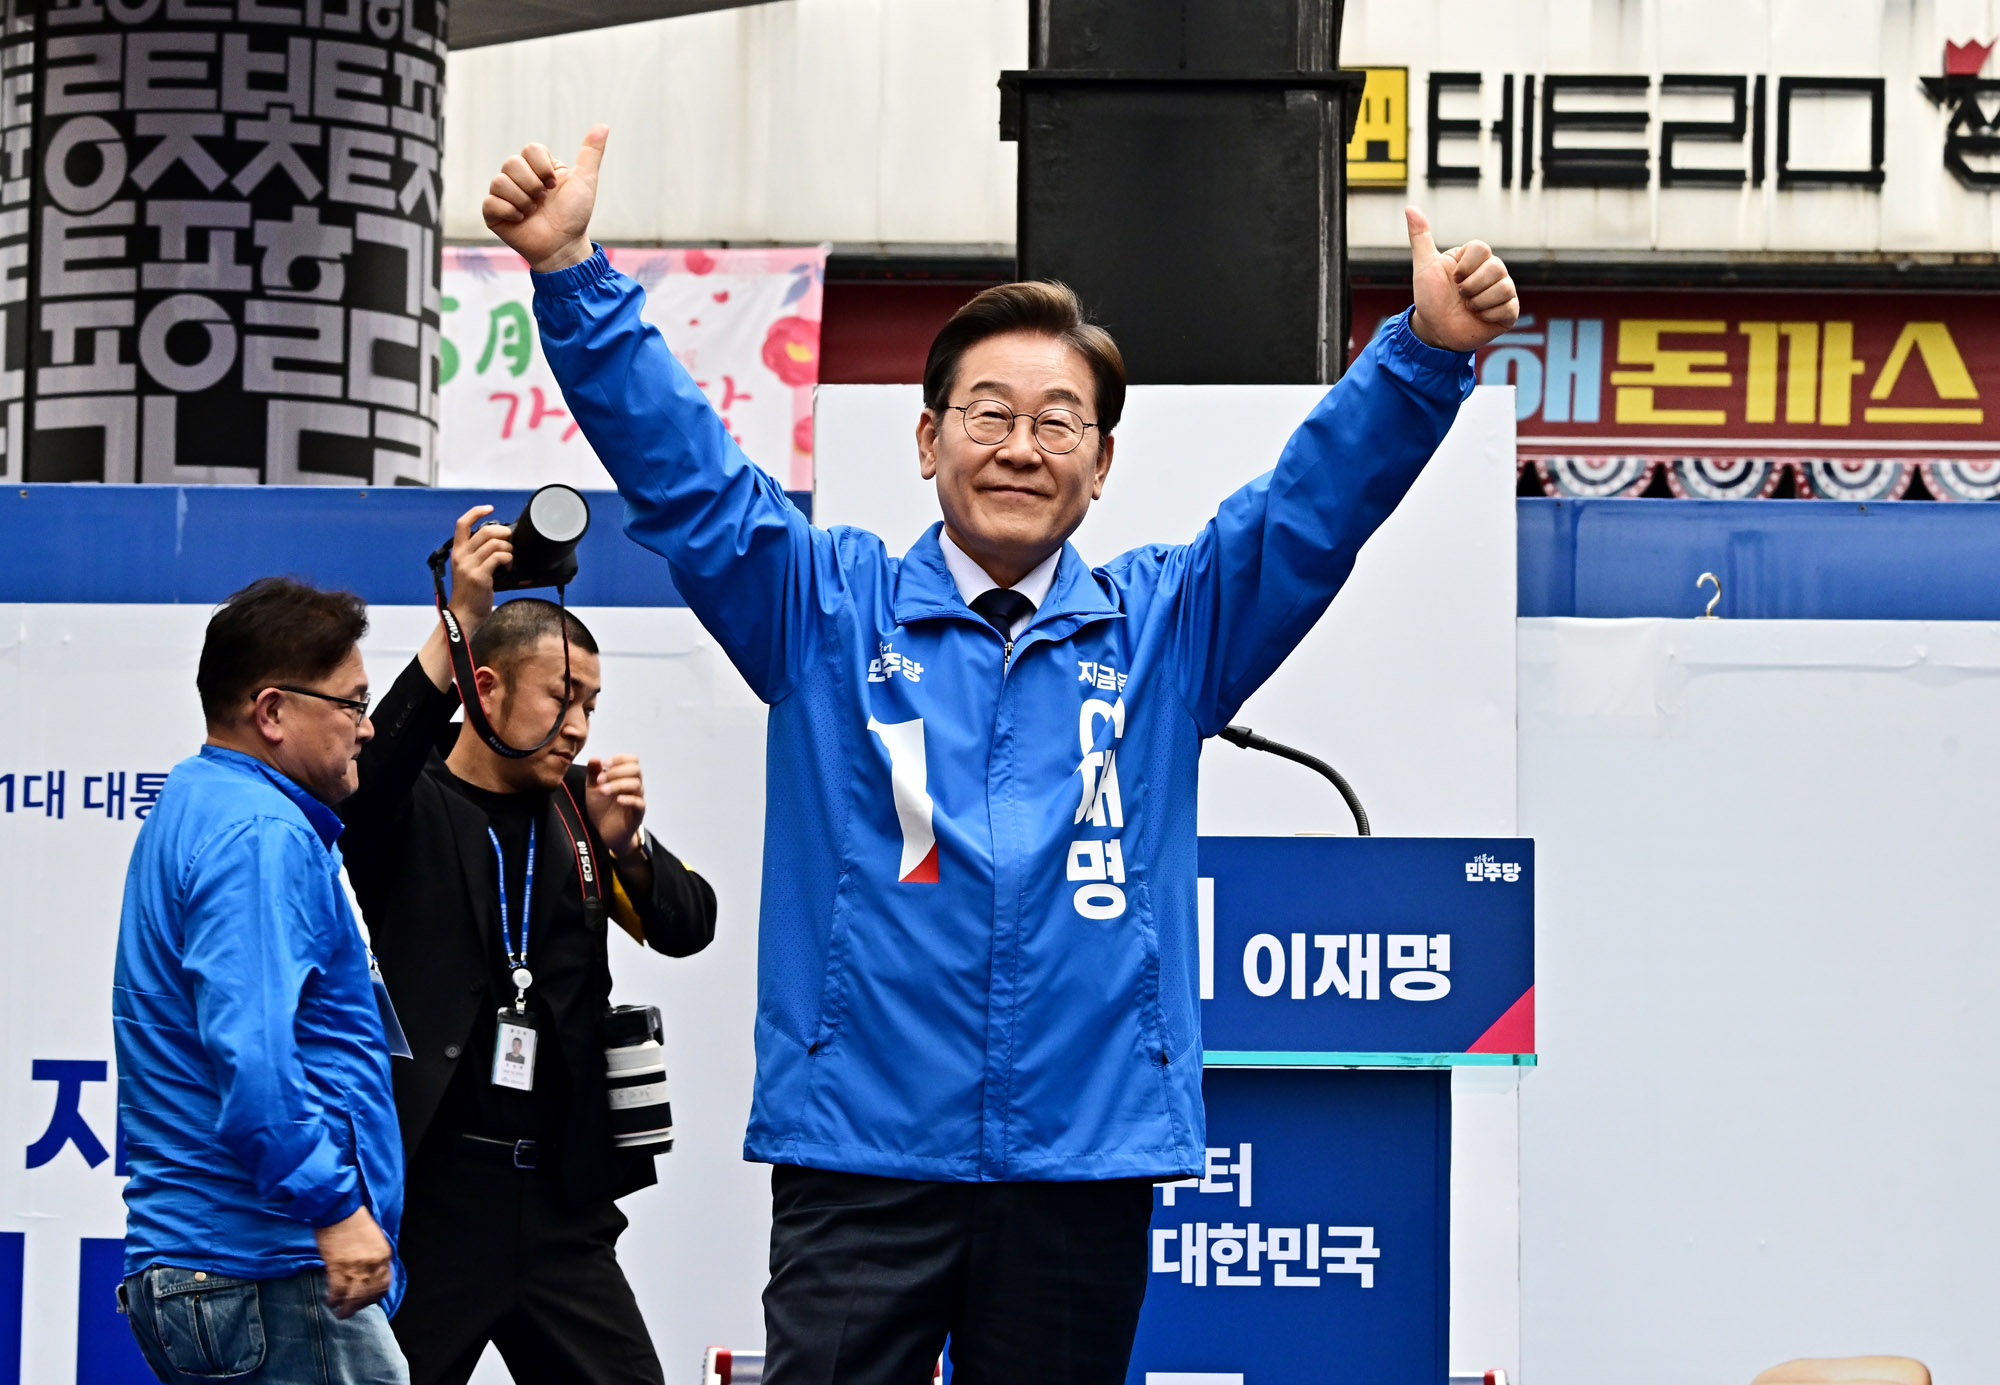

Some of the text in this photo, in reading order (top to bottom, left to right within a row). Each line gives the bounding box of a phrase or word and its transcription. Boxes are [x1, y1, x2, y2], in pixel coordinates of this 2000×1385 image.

[867, 652, 924, 683] 민주당
[867, 714, 940, 883] 1
[580, 855, 593, 882] EOS
[1465, 862, 1522, 883] 민주당
[1242, 932, 1451, 1001] 이재명
[1151, 1222, 1381, 1289] 대한민국
